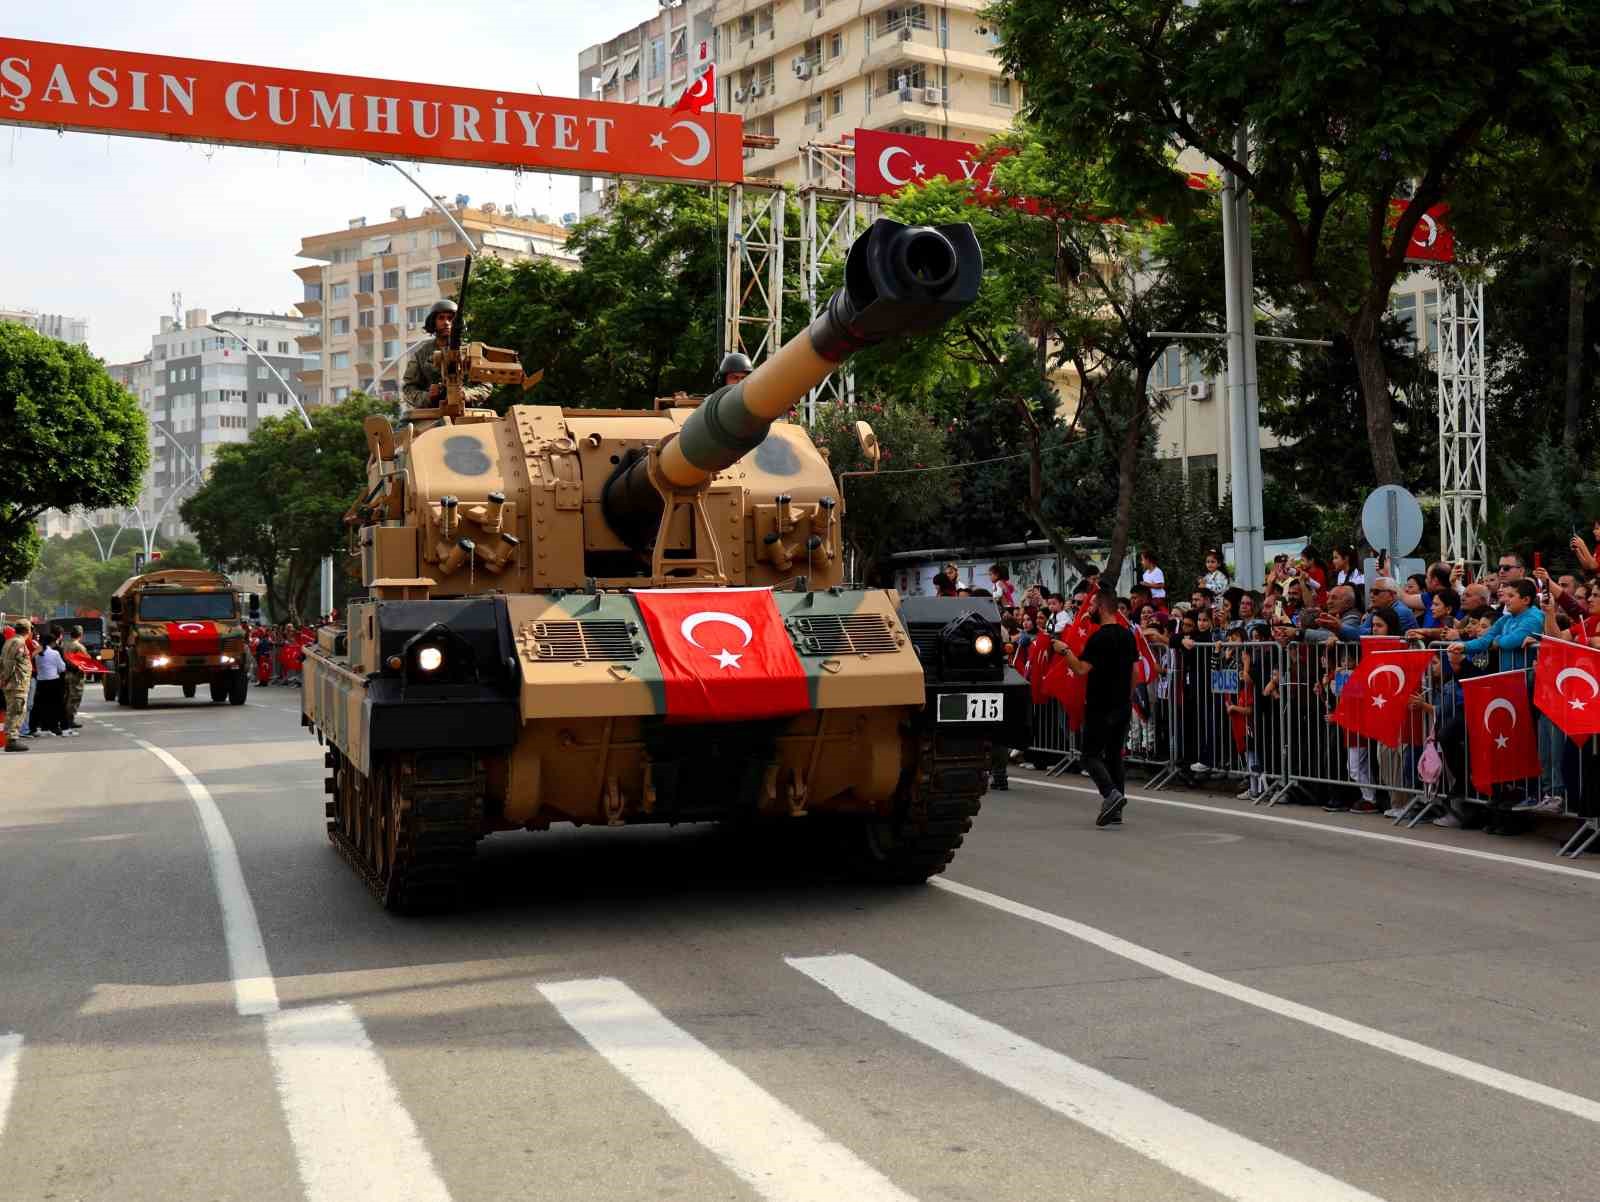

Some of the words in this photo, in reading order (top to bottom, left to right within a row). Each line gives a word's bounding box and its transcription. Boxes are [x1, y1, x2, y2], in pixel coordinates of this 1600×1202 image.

[0, 56, 197, 116] ŞASIN
[224, 81, 615, 153] CUMHURİYET
[970, 698, 999, 719] 715
